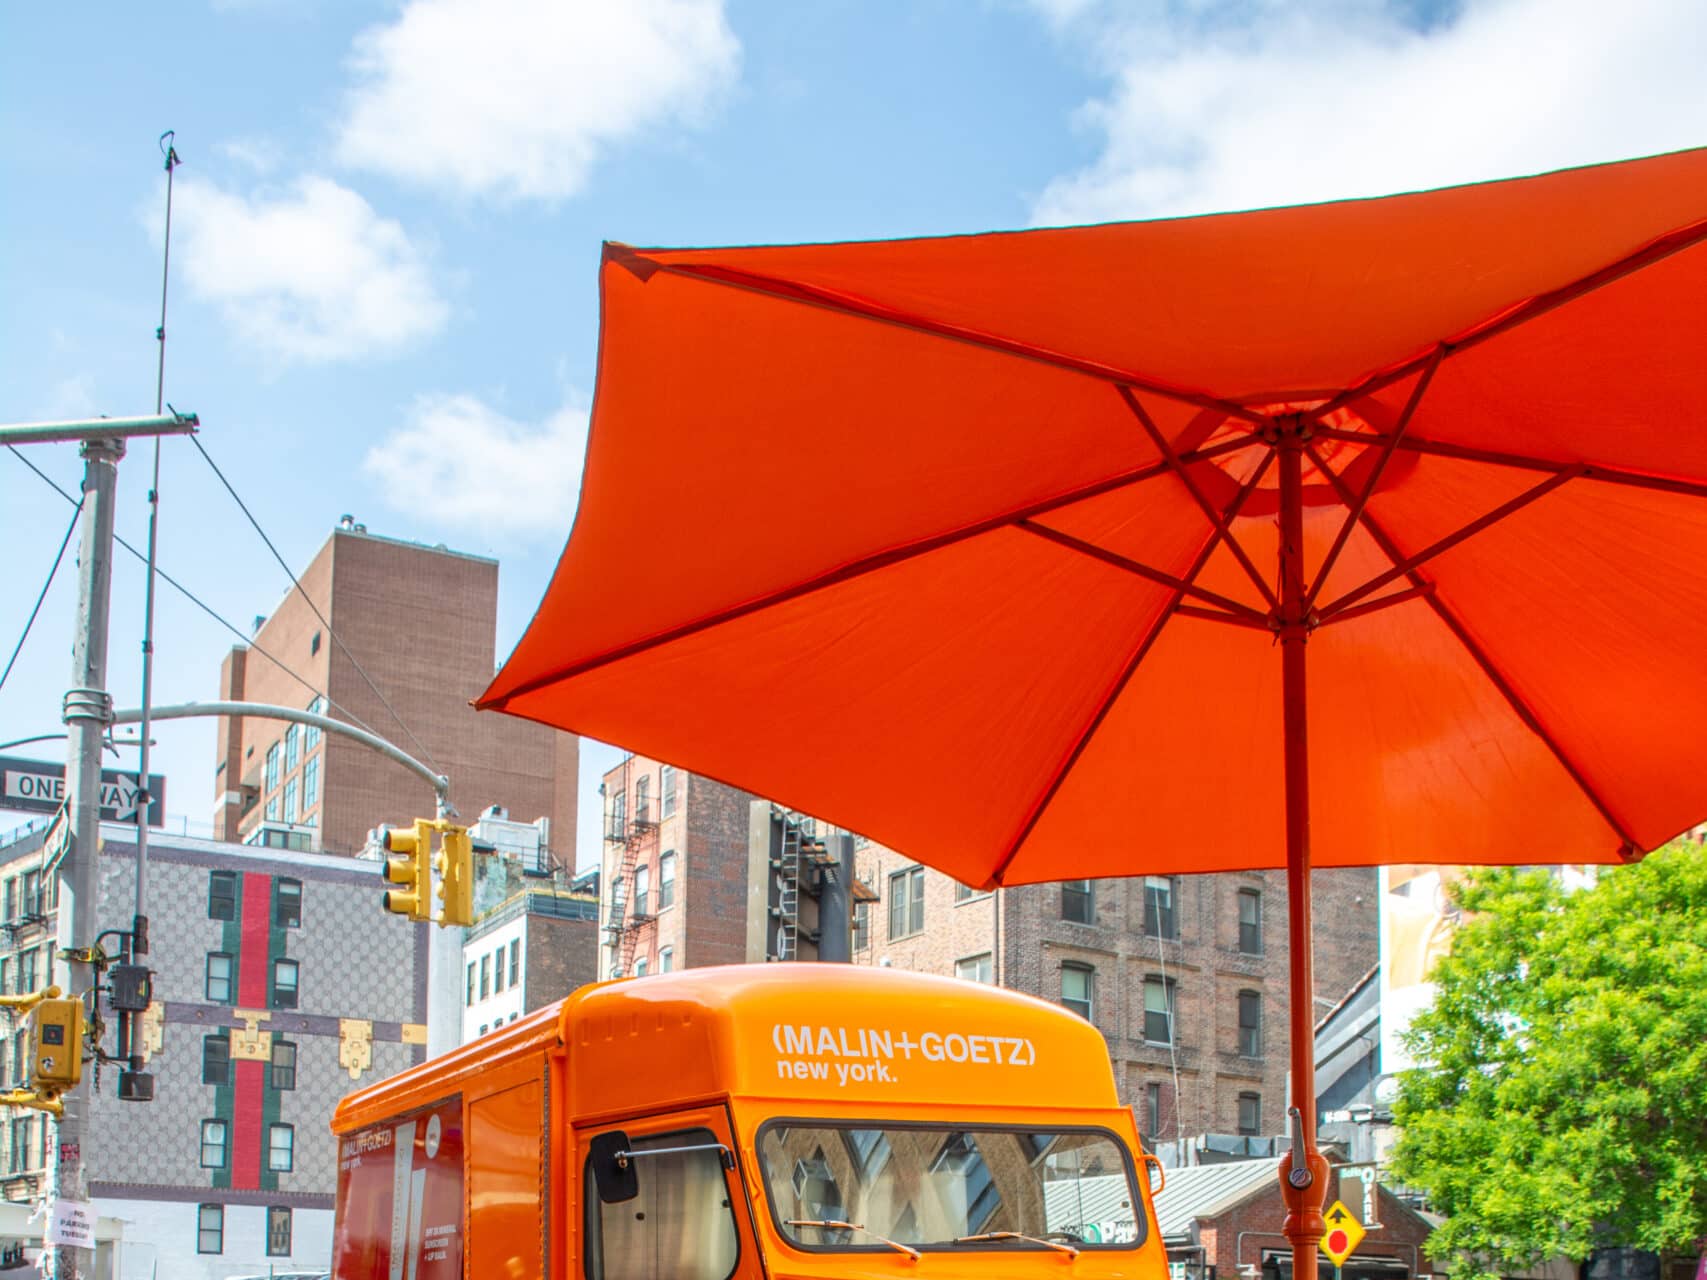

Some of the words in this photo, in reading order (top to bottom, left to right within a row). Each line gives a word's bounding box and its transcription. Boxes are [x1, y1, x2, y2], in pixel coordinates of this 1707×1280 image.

[19, 776, 65, 800] ONE
[772, 1024, 1036, 1066] (MALIN+GOETZ)
[777, 1060, 829, 1080] new
[835, 1060, 898, 1087] york.
